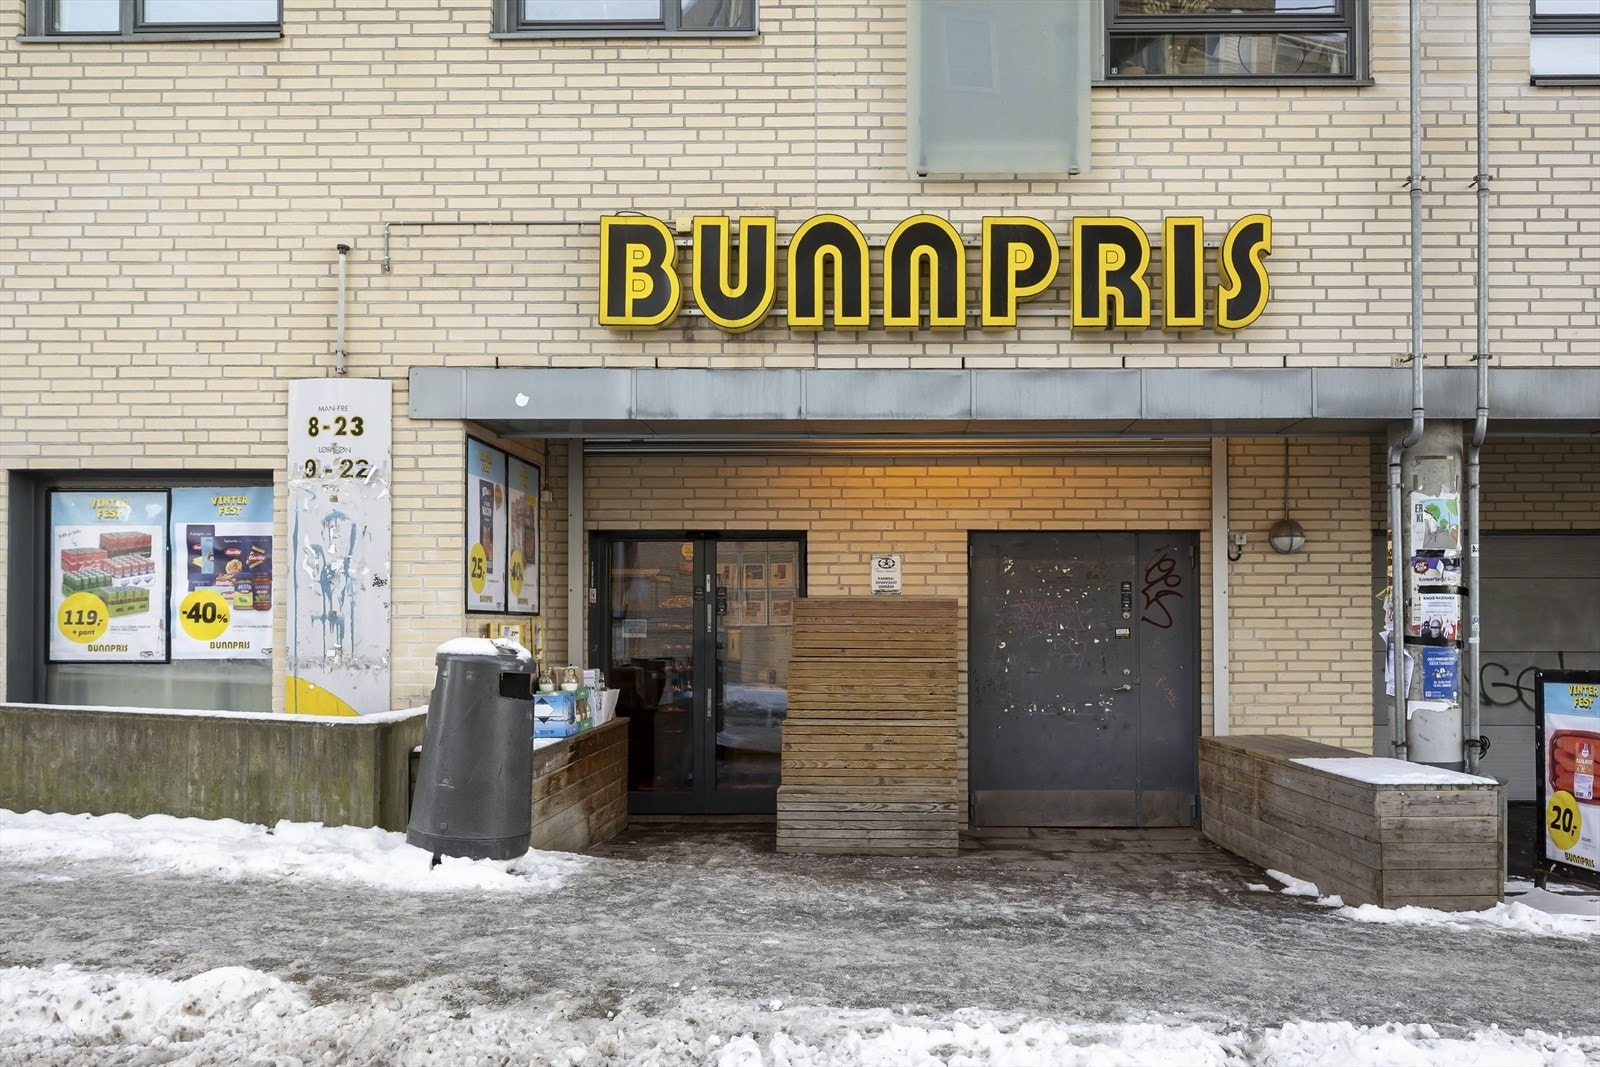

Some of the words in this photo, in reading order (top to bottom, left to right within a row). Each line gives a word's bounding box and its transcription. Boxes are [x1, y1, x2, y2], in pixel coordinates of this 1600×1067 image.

[600, 213, 1272, 332] BUNNPRIS
[210, 495, 249, 507] VINTER
[218, 505, 242, 516] FEST
[182, 602, 228, 624] -40%
[78, 629, 95, 637] pant
[87, 644, 128, 653] BUNNPRIS
[209, 641, 250, 650] BUNNPRIS
[1568, 685, 1599, 699] VINTER
[1573, 697, 1594, 710] FEST
[1564, 852, 1595, 869] BUNNPRIS
